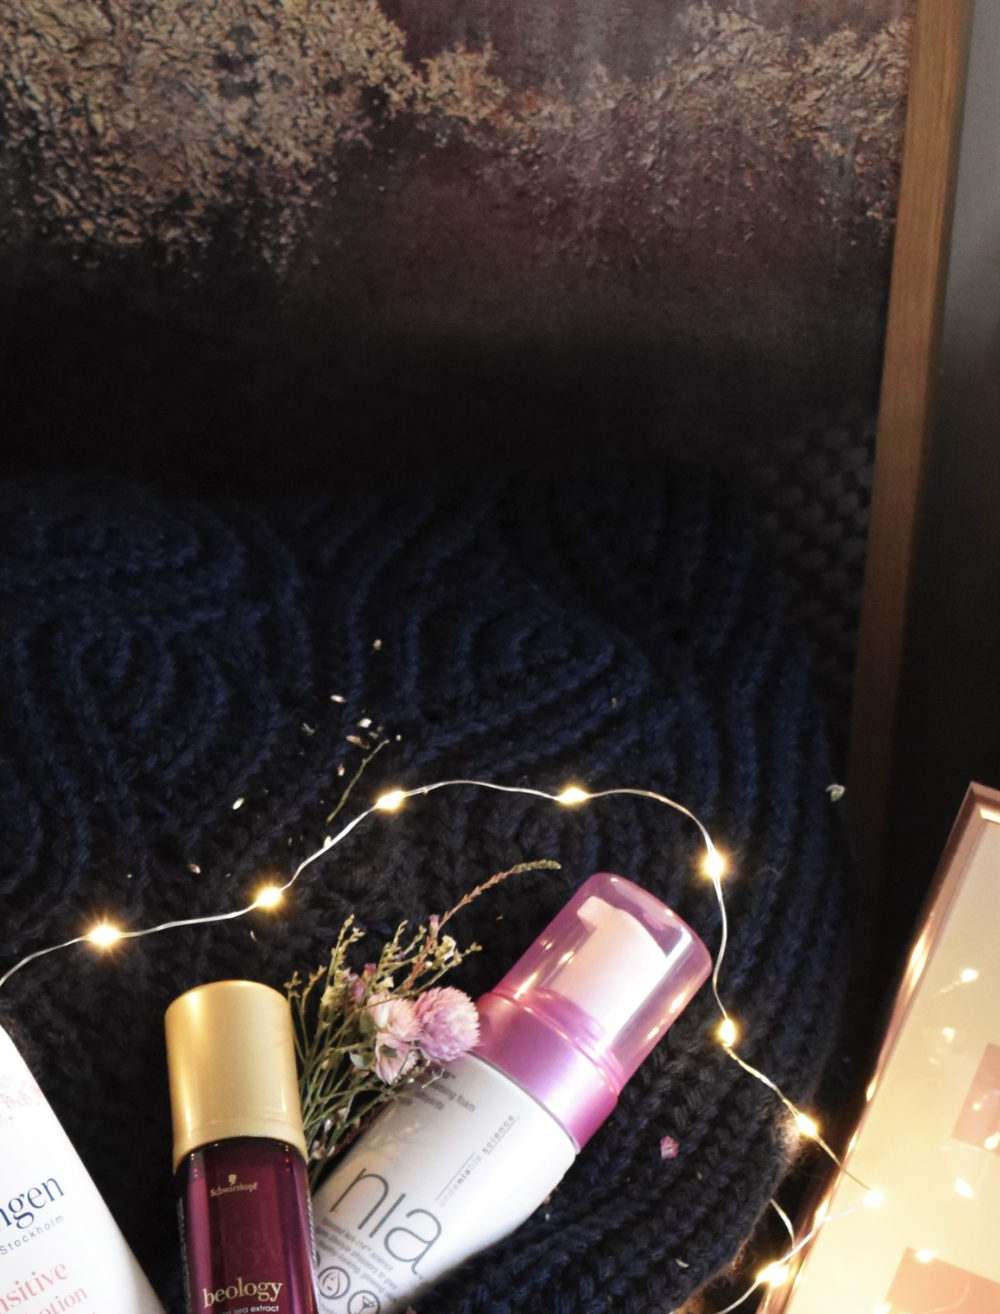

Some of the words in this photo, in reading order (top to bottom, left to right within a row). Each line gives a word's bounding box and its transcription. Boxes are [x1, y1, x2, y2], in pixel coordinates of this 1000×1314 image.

[0, 1214, 64, 1256] Stockholm
[330, 1168, 442, 1275] nia
[202, 1277, 283, 1308] beology
[233, 1306, 249, 1314] sea
[250, 1304, 280, 1313] extract
